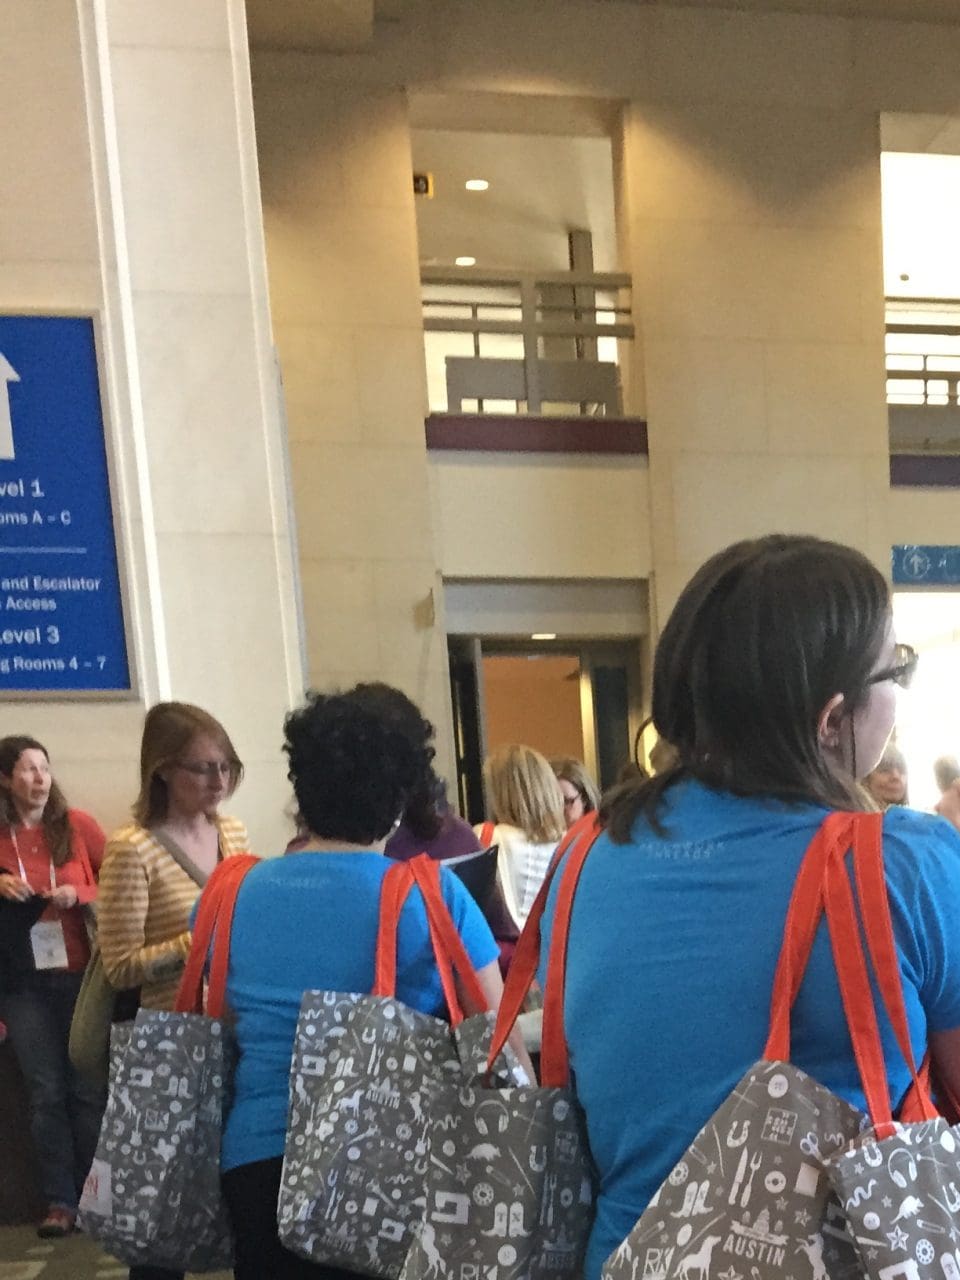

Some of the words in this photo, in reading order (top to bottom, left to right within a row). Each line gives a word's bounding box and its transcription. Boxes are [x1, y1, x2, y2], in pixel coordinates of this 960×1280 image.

[31, 479, 45, 498] 1
[32, 509, 43, 525] A
[1, 576, 29, 591] and
[33, 575, 100, 592] Escalator
[6, 595, 57, 611] Access
[0, 626, 41, 645] evel
[46, 625, 60, 645] 3
[13, 655, 65, 671] Rooms
[68, 656, 79, 671] 4
[96, 655, 106, 671] 7
[722, 1233, 786, 1268] AUSTIN
